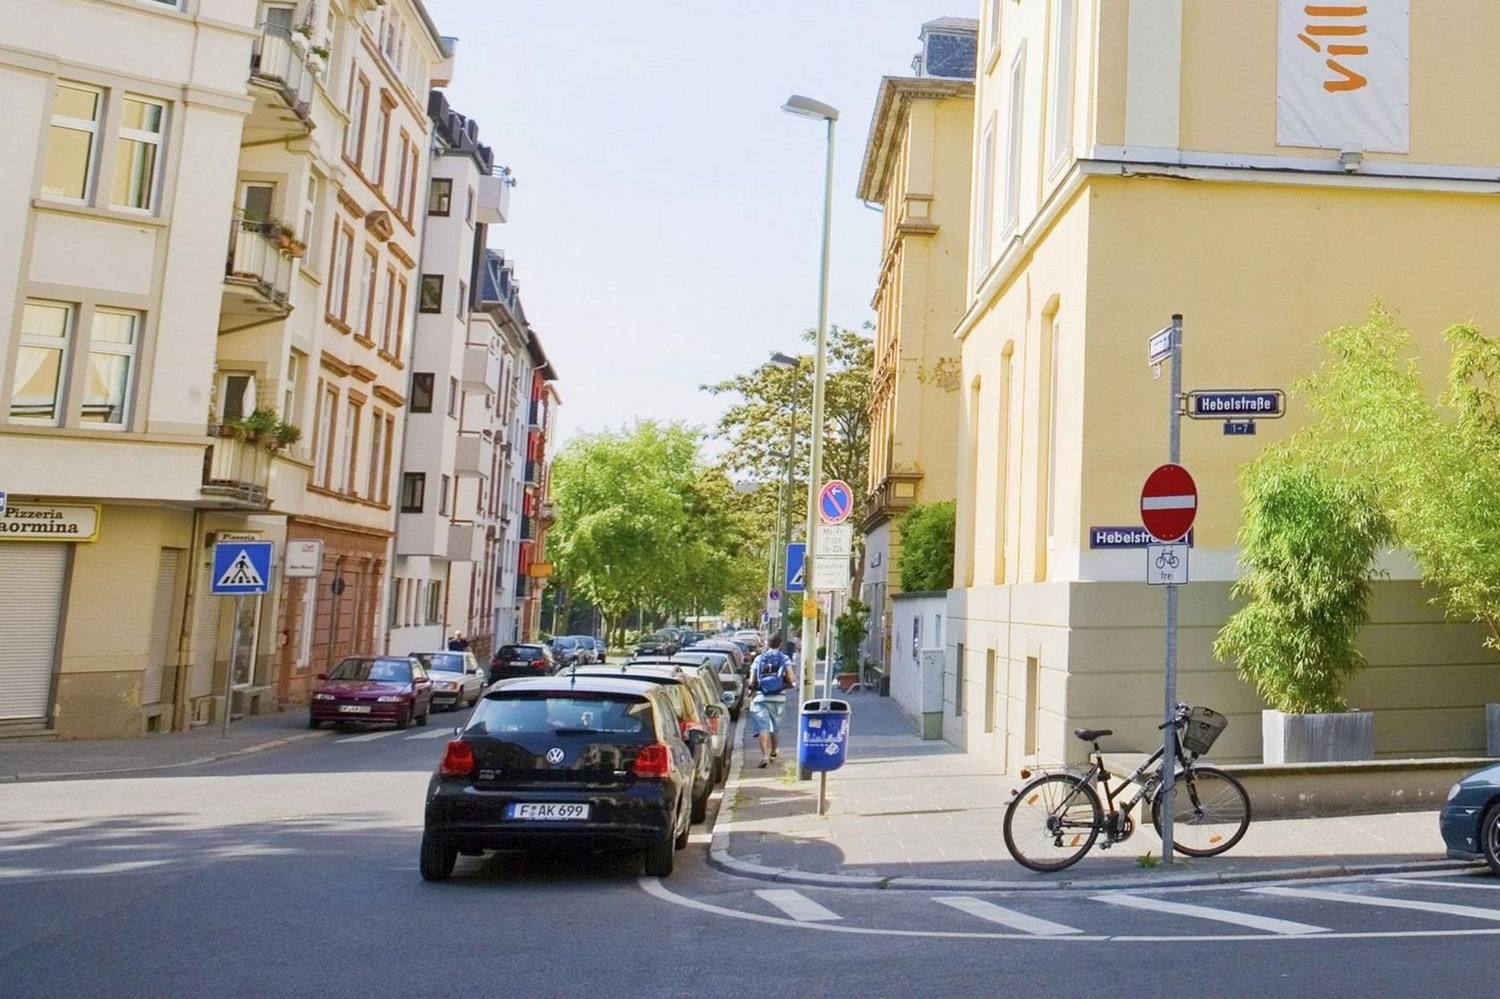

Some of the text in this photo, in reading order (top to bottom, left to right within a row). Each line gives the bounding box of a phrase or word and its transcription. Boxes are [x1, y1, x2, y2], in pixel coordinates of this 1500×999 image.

[1201, 396, 1272, 412] Hebelstraße
[1231, 423, 1249, 434] 1-7
[4, 507, 64, 520] Pizzeria
[0, 519, 80, 534] aormina
[1096, 531, 1159, 544] Hebelstr
[1160, 570, 1175, 580] frei
[537, 805, 556, 817] AK
[558, 804, 584, 817] 699
